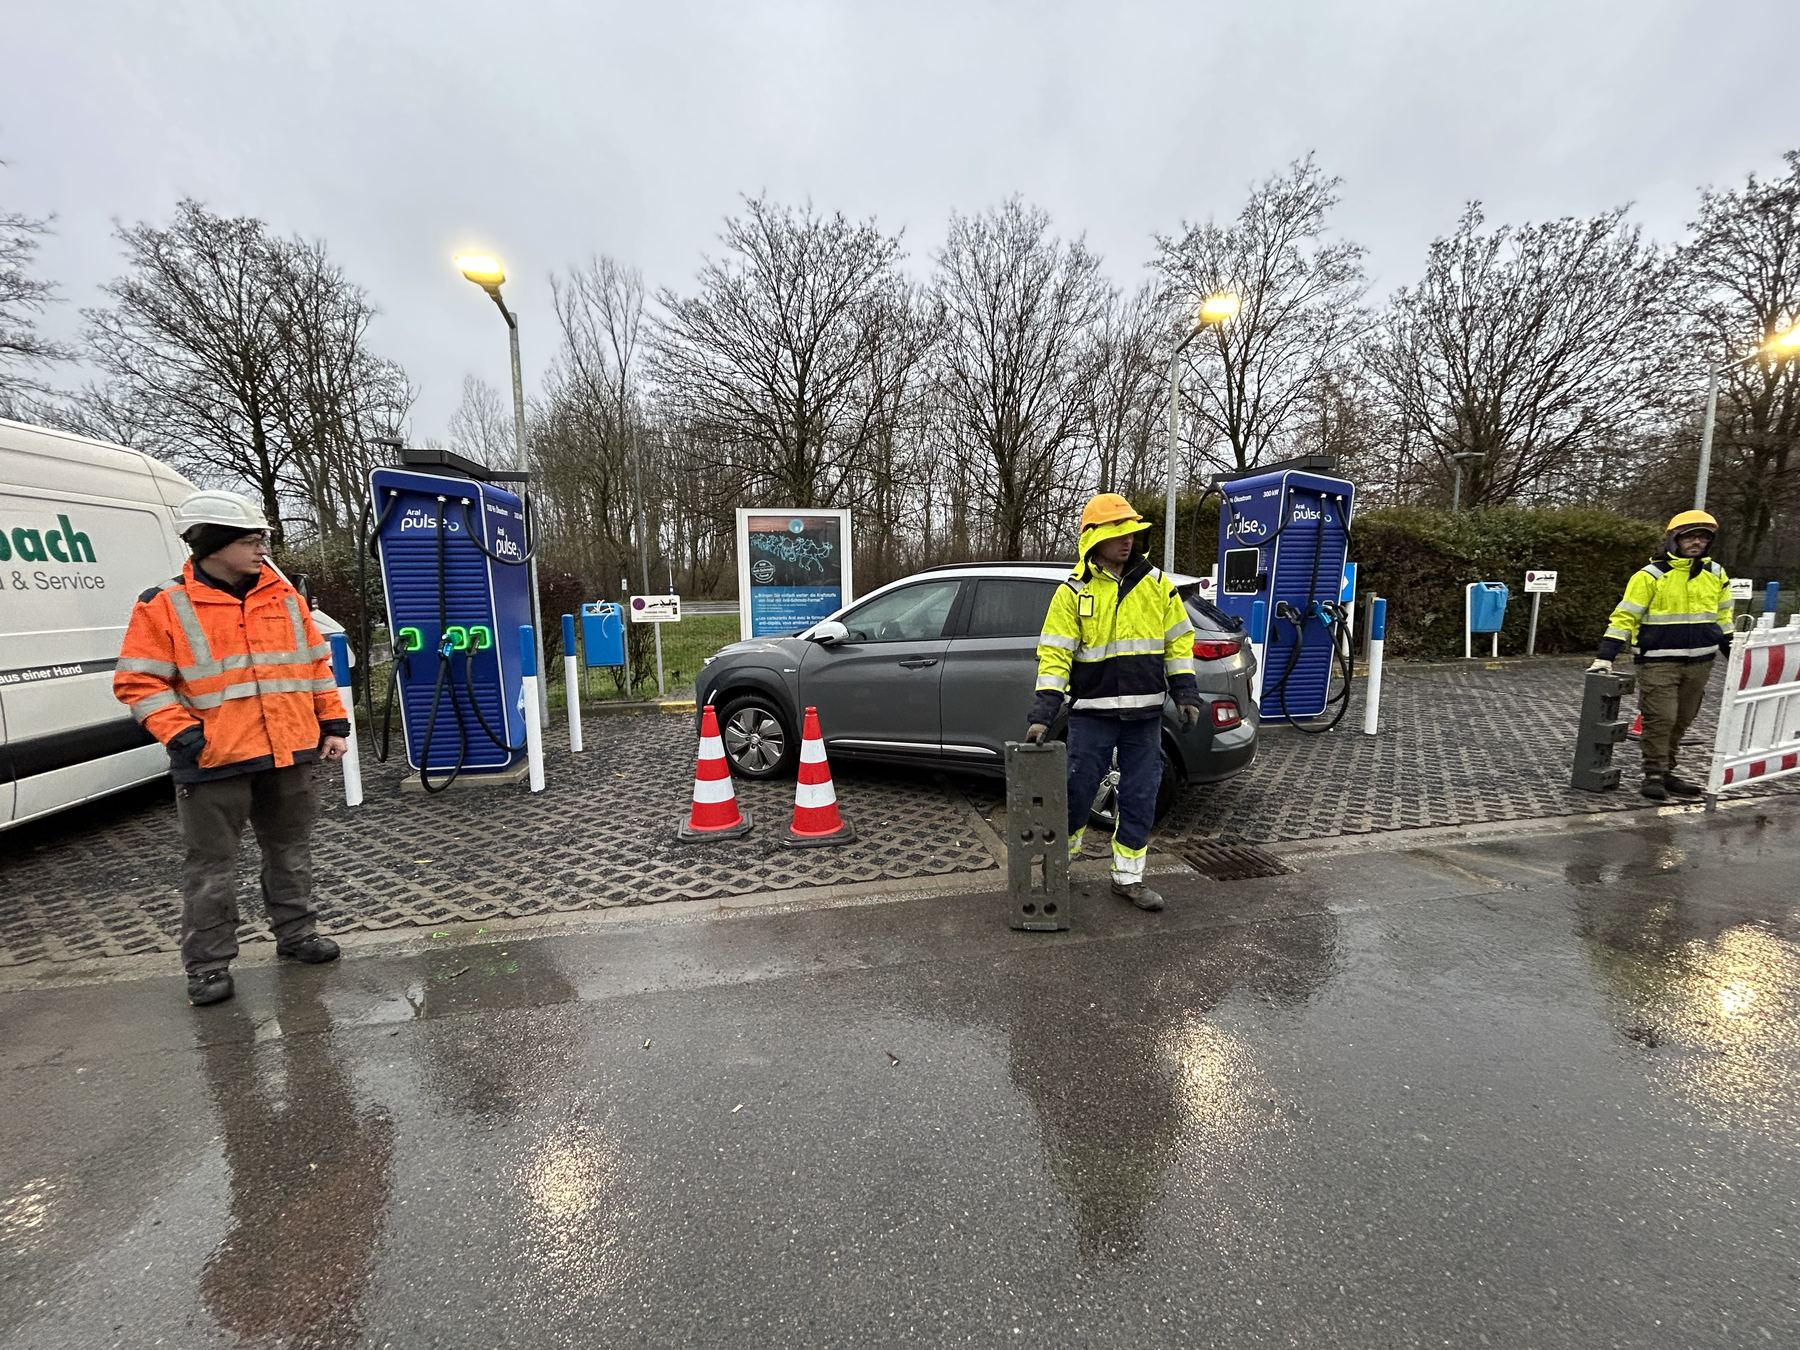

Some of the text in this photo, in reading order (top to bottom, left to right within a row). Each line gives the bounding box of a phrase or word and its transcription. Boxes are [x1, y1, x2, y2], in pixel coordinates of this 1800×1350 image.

[1226, 516, 1258, 539] pulse
[496, 534, 517, 558] pulse
[11, 570, 30, 591] &
[33, 570, 106, 591] Service
[0, 664, 83, 684] aus einer Hand
